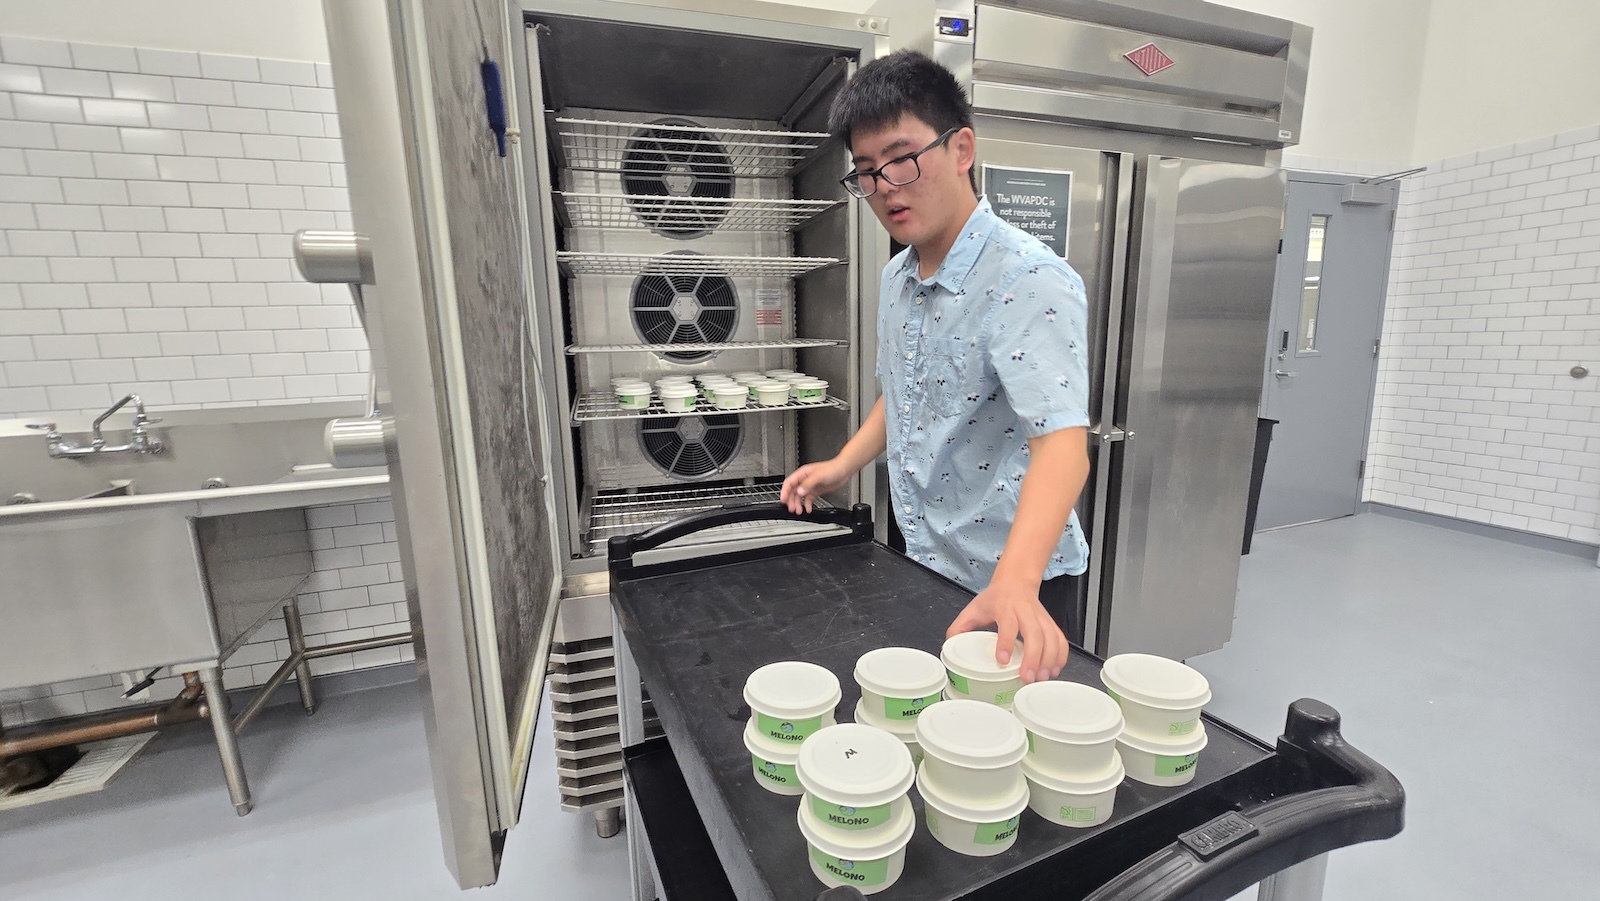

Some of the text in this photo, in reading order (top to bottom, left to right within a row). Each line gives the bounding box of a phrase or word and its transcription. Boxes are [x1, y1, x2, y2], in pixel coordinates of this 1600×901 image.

[997, 193, 1056, 206] The WVAPDC is
[1000, 208, 1052, 220] not responsible
[1021, 221, 1029, 229] or
[1029, 219, 1047, 229] theft
[1047, 220, 1057, 230] of
[902, 706, 925, 717] MELO
[770, 730, 804, 741] MELONO
[758, 766, 787, 783] MELONO
[828, 813, 870, 825] MELONO
[826, 862, 866, 881] MELONO
